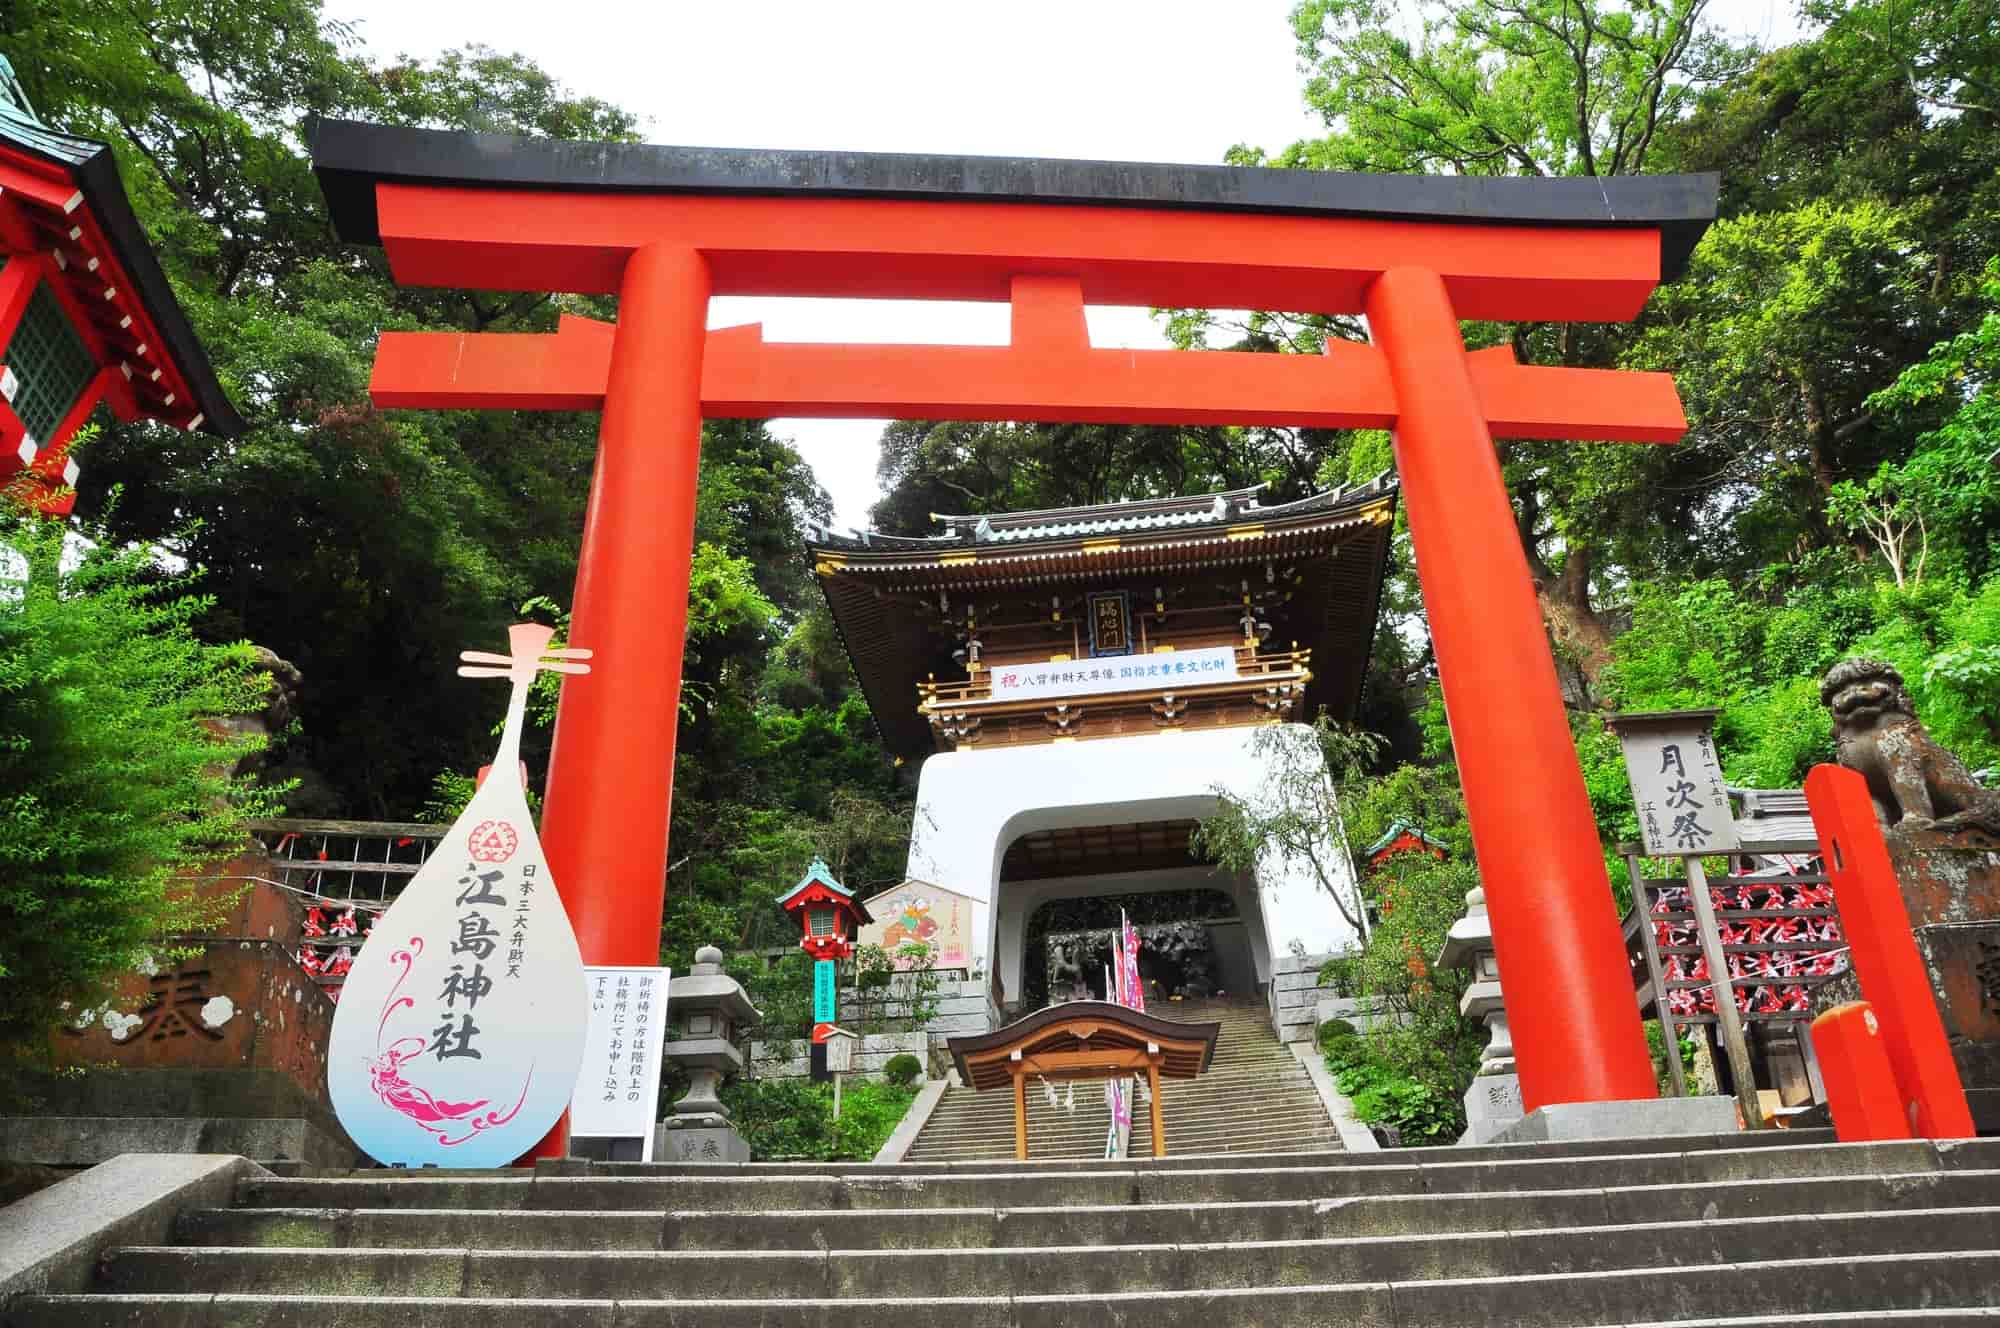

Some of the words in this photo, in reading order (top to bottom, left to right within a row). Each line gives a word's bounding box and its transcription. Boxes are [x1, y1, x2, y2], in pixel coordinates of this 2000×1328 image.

[1000, 672, 1019, 688] 祝
[1659, 744, 1713, 849] 月次祭
[426, 863, 507, 1062] 江島神社
[506, 864, 537, 978] 日本三大弁財天
[592, 976, 608, 1012] 下さい
[602, 977, 630, 1102] 社務所にてお申し込み
